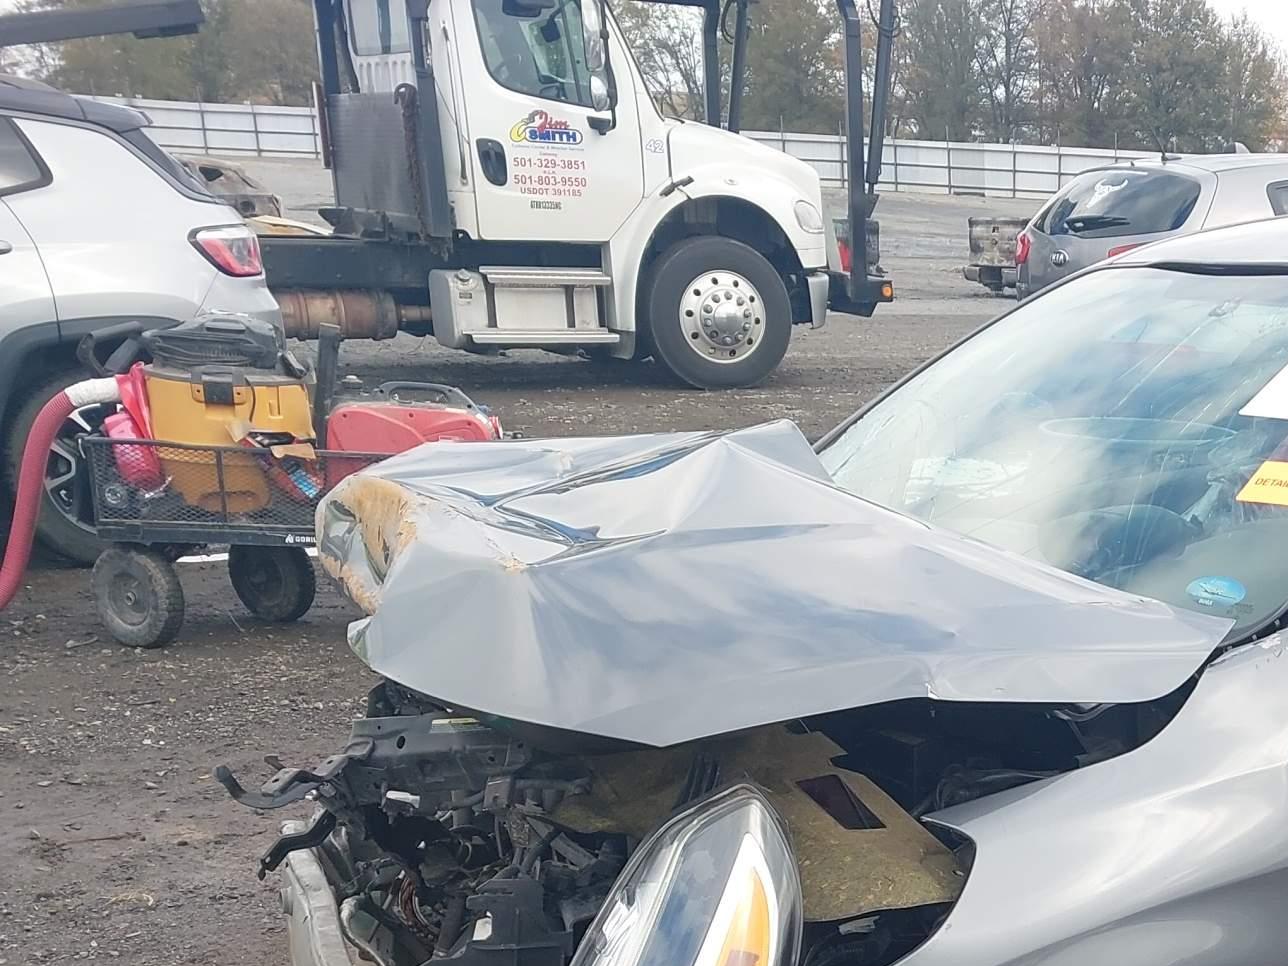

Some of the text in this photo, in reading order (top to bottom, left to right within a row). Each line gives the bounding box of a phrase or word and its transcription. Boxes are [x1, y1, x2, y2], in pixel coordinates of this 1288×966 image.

[528, 129, 577, 142] SMITH
[645, 138, 665, 153] 42
[513, 156, 586, 170] 501-329-3851
[513, 174, 587, 188] 501-803-9550
[520, 187, 582, 197] USDOT 391185
